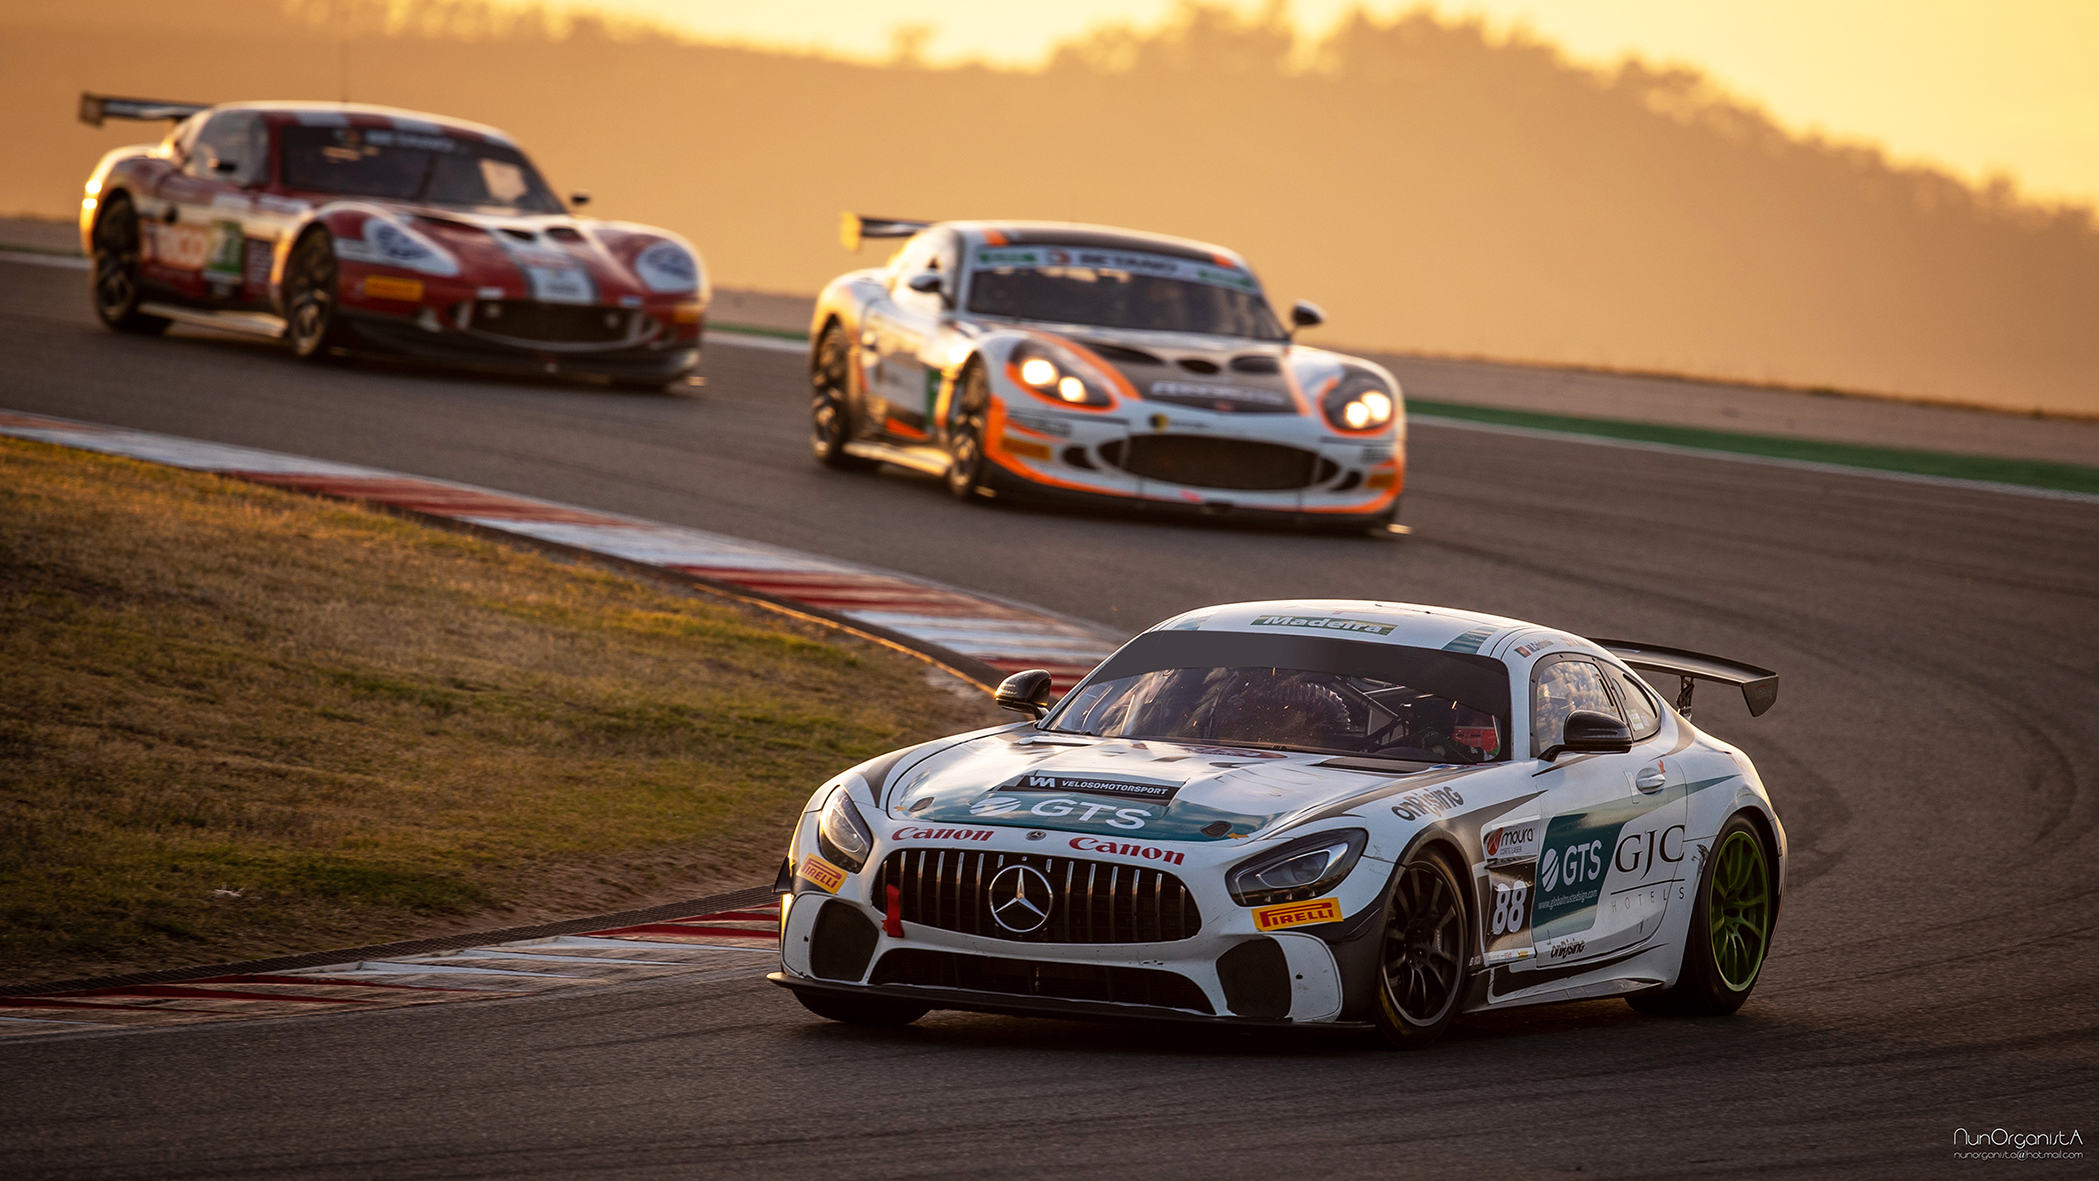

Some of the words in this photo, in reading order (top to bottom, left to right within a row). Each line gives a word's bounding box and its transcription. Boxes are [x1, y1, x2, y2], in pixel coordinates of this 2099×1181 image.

[1264, 616, 1383, 633] Madeira
[1062, 780, 1168, 796] VELOSOMOTORSPORT
[1031, 799, 1152, 830] GTS
[891, 827, 994, 842] Canon
[1501, 828, 1534, 847] moura
[1069, 837, 1185, 866] Canon
[1563, 839, 1602, 886] GTS
[1615, 824, 1686, 880] GJC
[802, 857, 843, 889] PIRELLI
[1259, 902, 1334, 928] PIRELLI
[1492, 880, 1527, 935] 88
